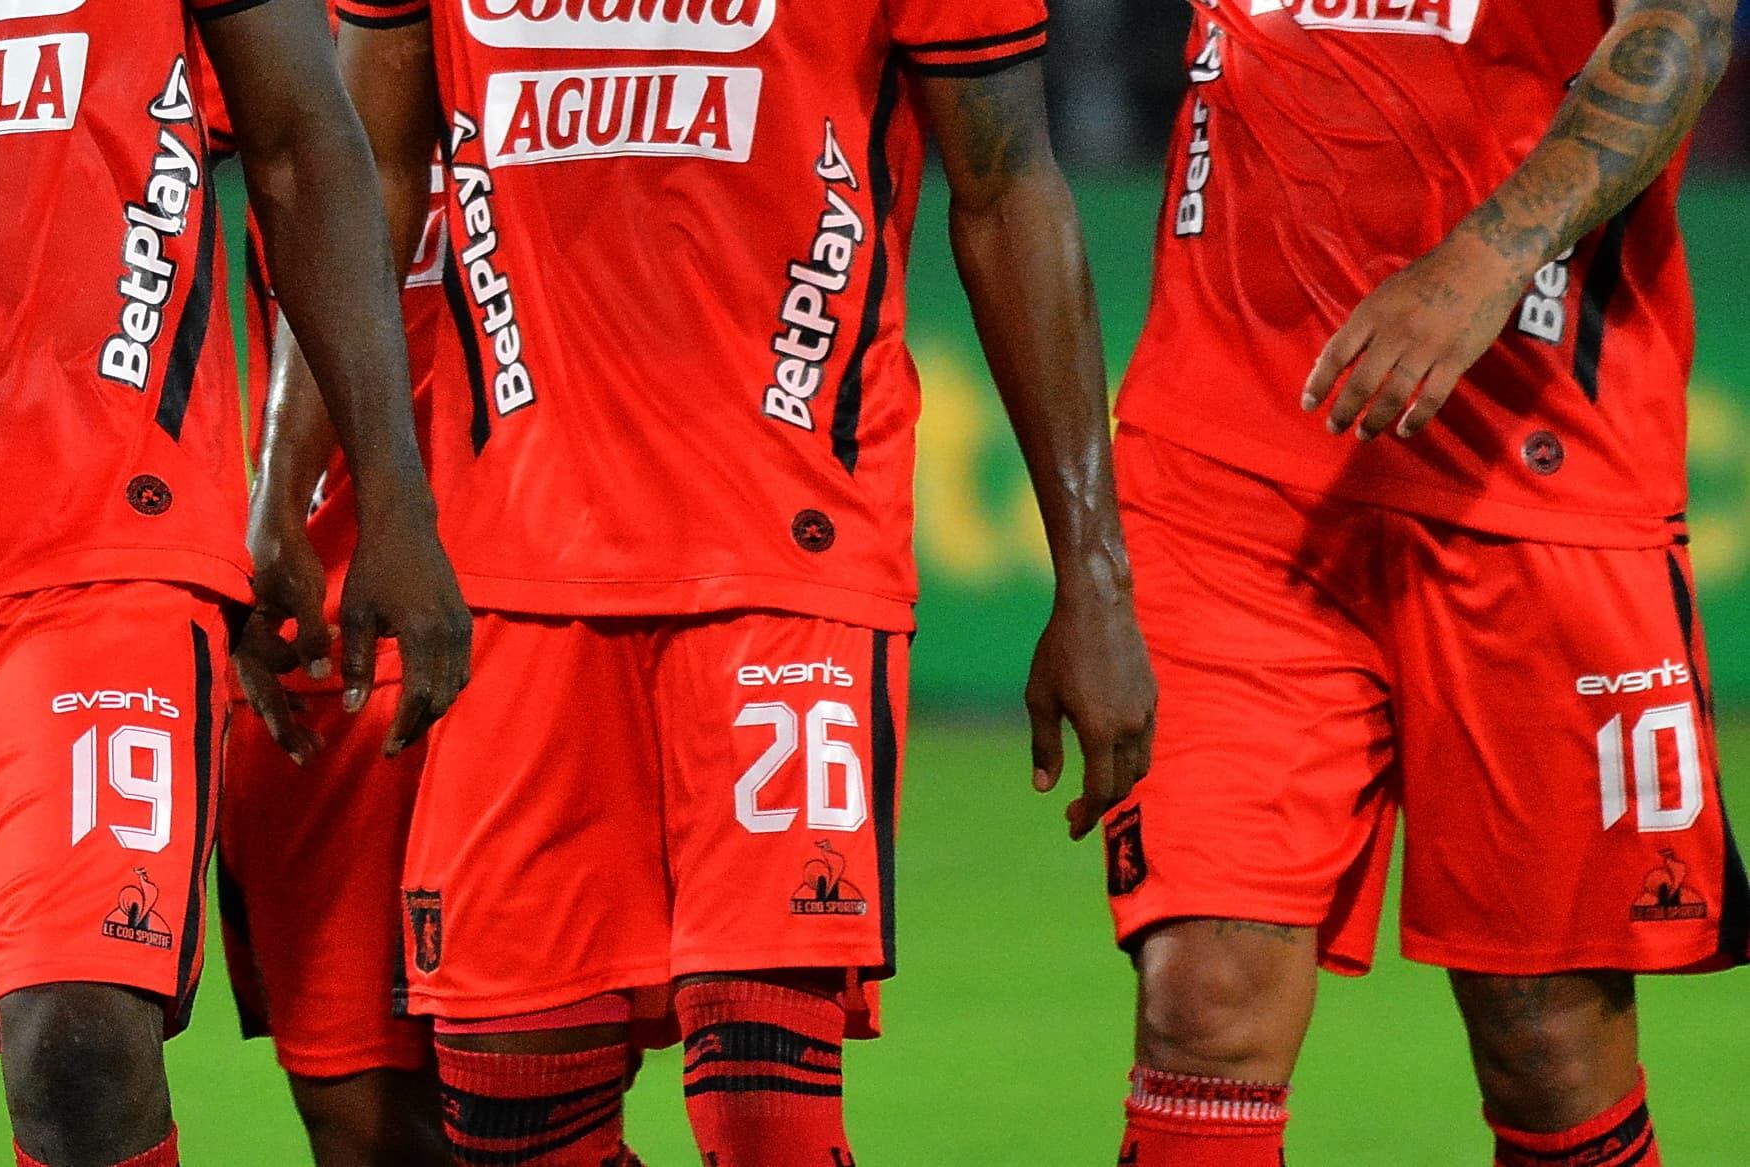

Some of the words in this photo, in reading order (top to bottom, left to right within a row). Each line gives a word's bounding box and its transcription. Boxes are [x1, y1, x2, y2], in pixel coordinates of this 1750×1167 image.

[496, 74, 733, 158] AGUILA
[102, 131, 199, 391] BetPlay
[453, 165, 535, 416] BetPlay
[764, 184, 864, 431] BetPlay
[70, 723, 173, 854] 19
[732, 699, 868, 834] 26
[1596, 701, 1704, 833] 10
